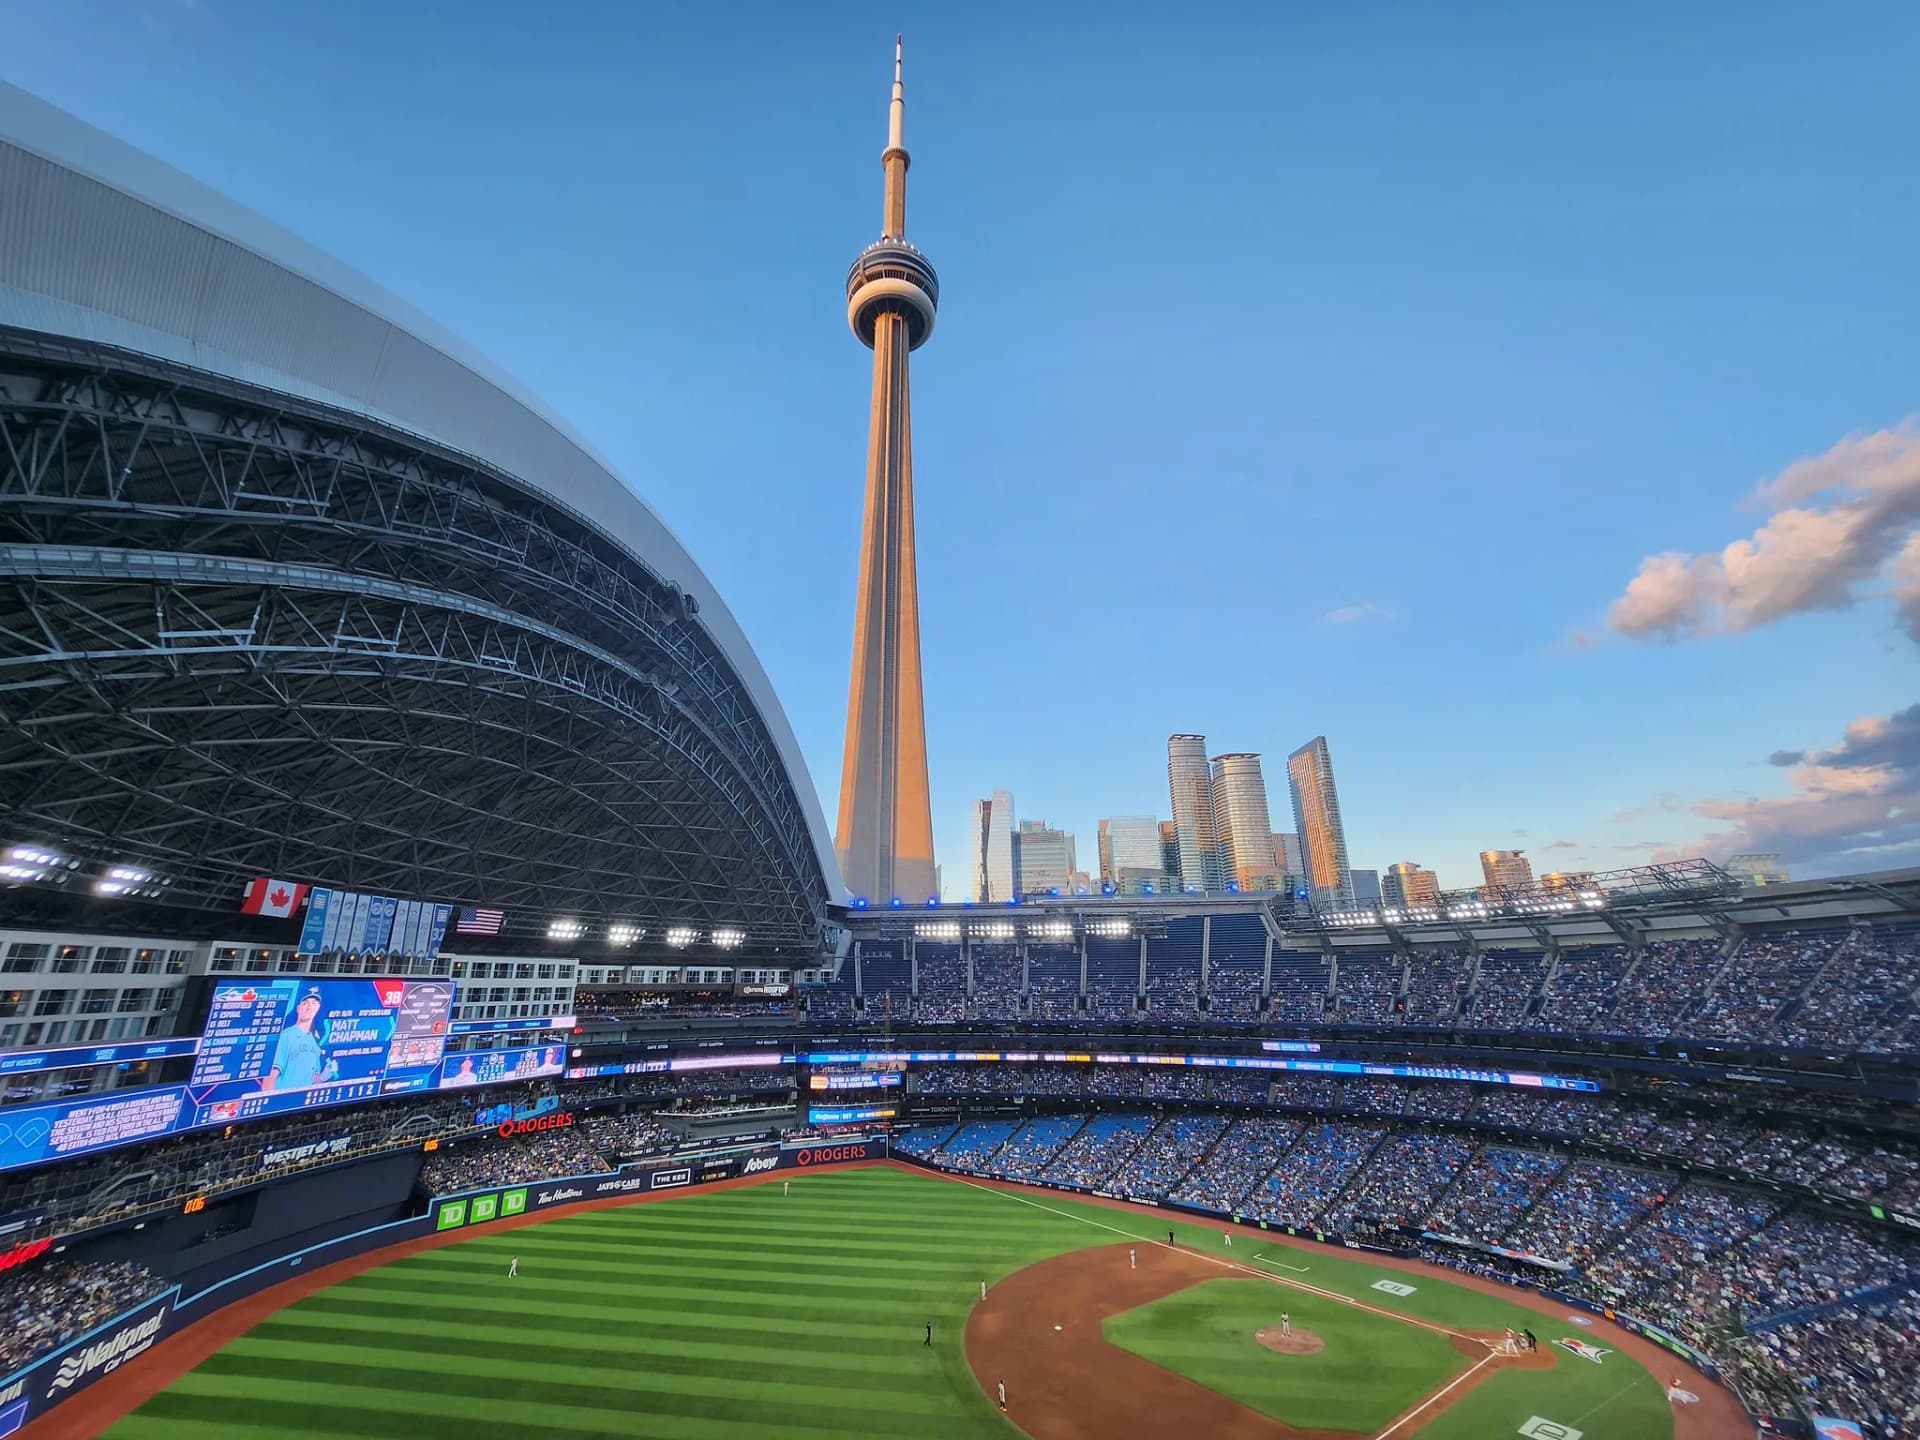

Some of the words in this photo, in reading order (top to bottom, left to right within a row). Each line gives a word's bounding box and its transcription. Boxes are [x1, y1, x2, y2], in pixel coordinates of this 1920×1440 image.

[432, 928, 446, 941] 37
[384, 991, 401, 1004] 3B
[331, 1019, 360, 1031] MATT
[328, 1029, 379, 1044] CHAPMAN
[366, 1084, 374, 1095] 2
[517, 1112, 573, 1133] ROGERS
[264, 1144, 317, 1165] WESTJET
[814, 1145, 866, 1162] ROGERS
[744, 1156, 778, 1173] Sobeys
[596, 1182, 614, 1192] JAYS
[621, 1178, 640, 1188] CARE
[506, 1193, 524, 1210] TD
[538, 1191, 552, 1205] Tim
[553, 1188, 583, 1201] Hortons
[443, 1204, 463, 1224] TD
[474, 1199, 495, 1217] TD
[1344, 1240, 1360, 1248] VISA
[78, 1306, 165, 1377] National
[104, 1357, 120, 1374] Car
